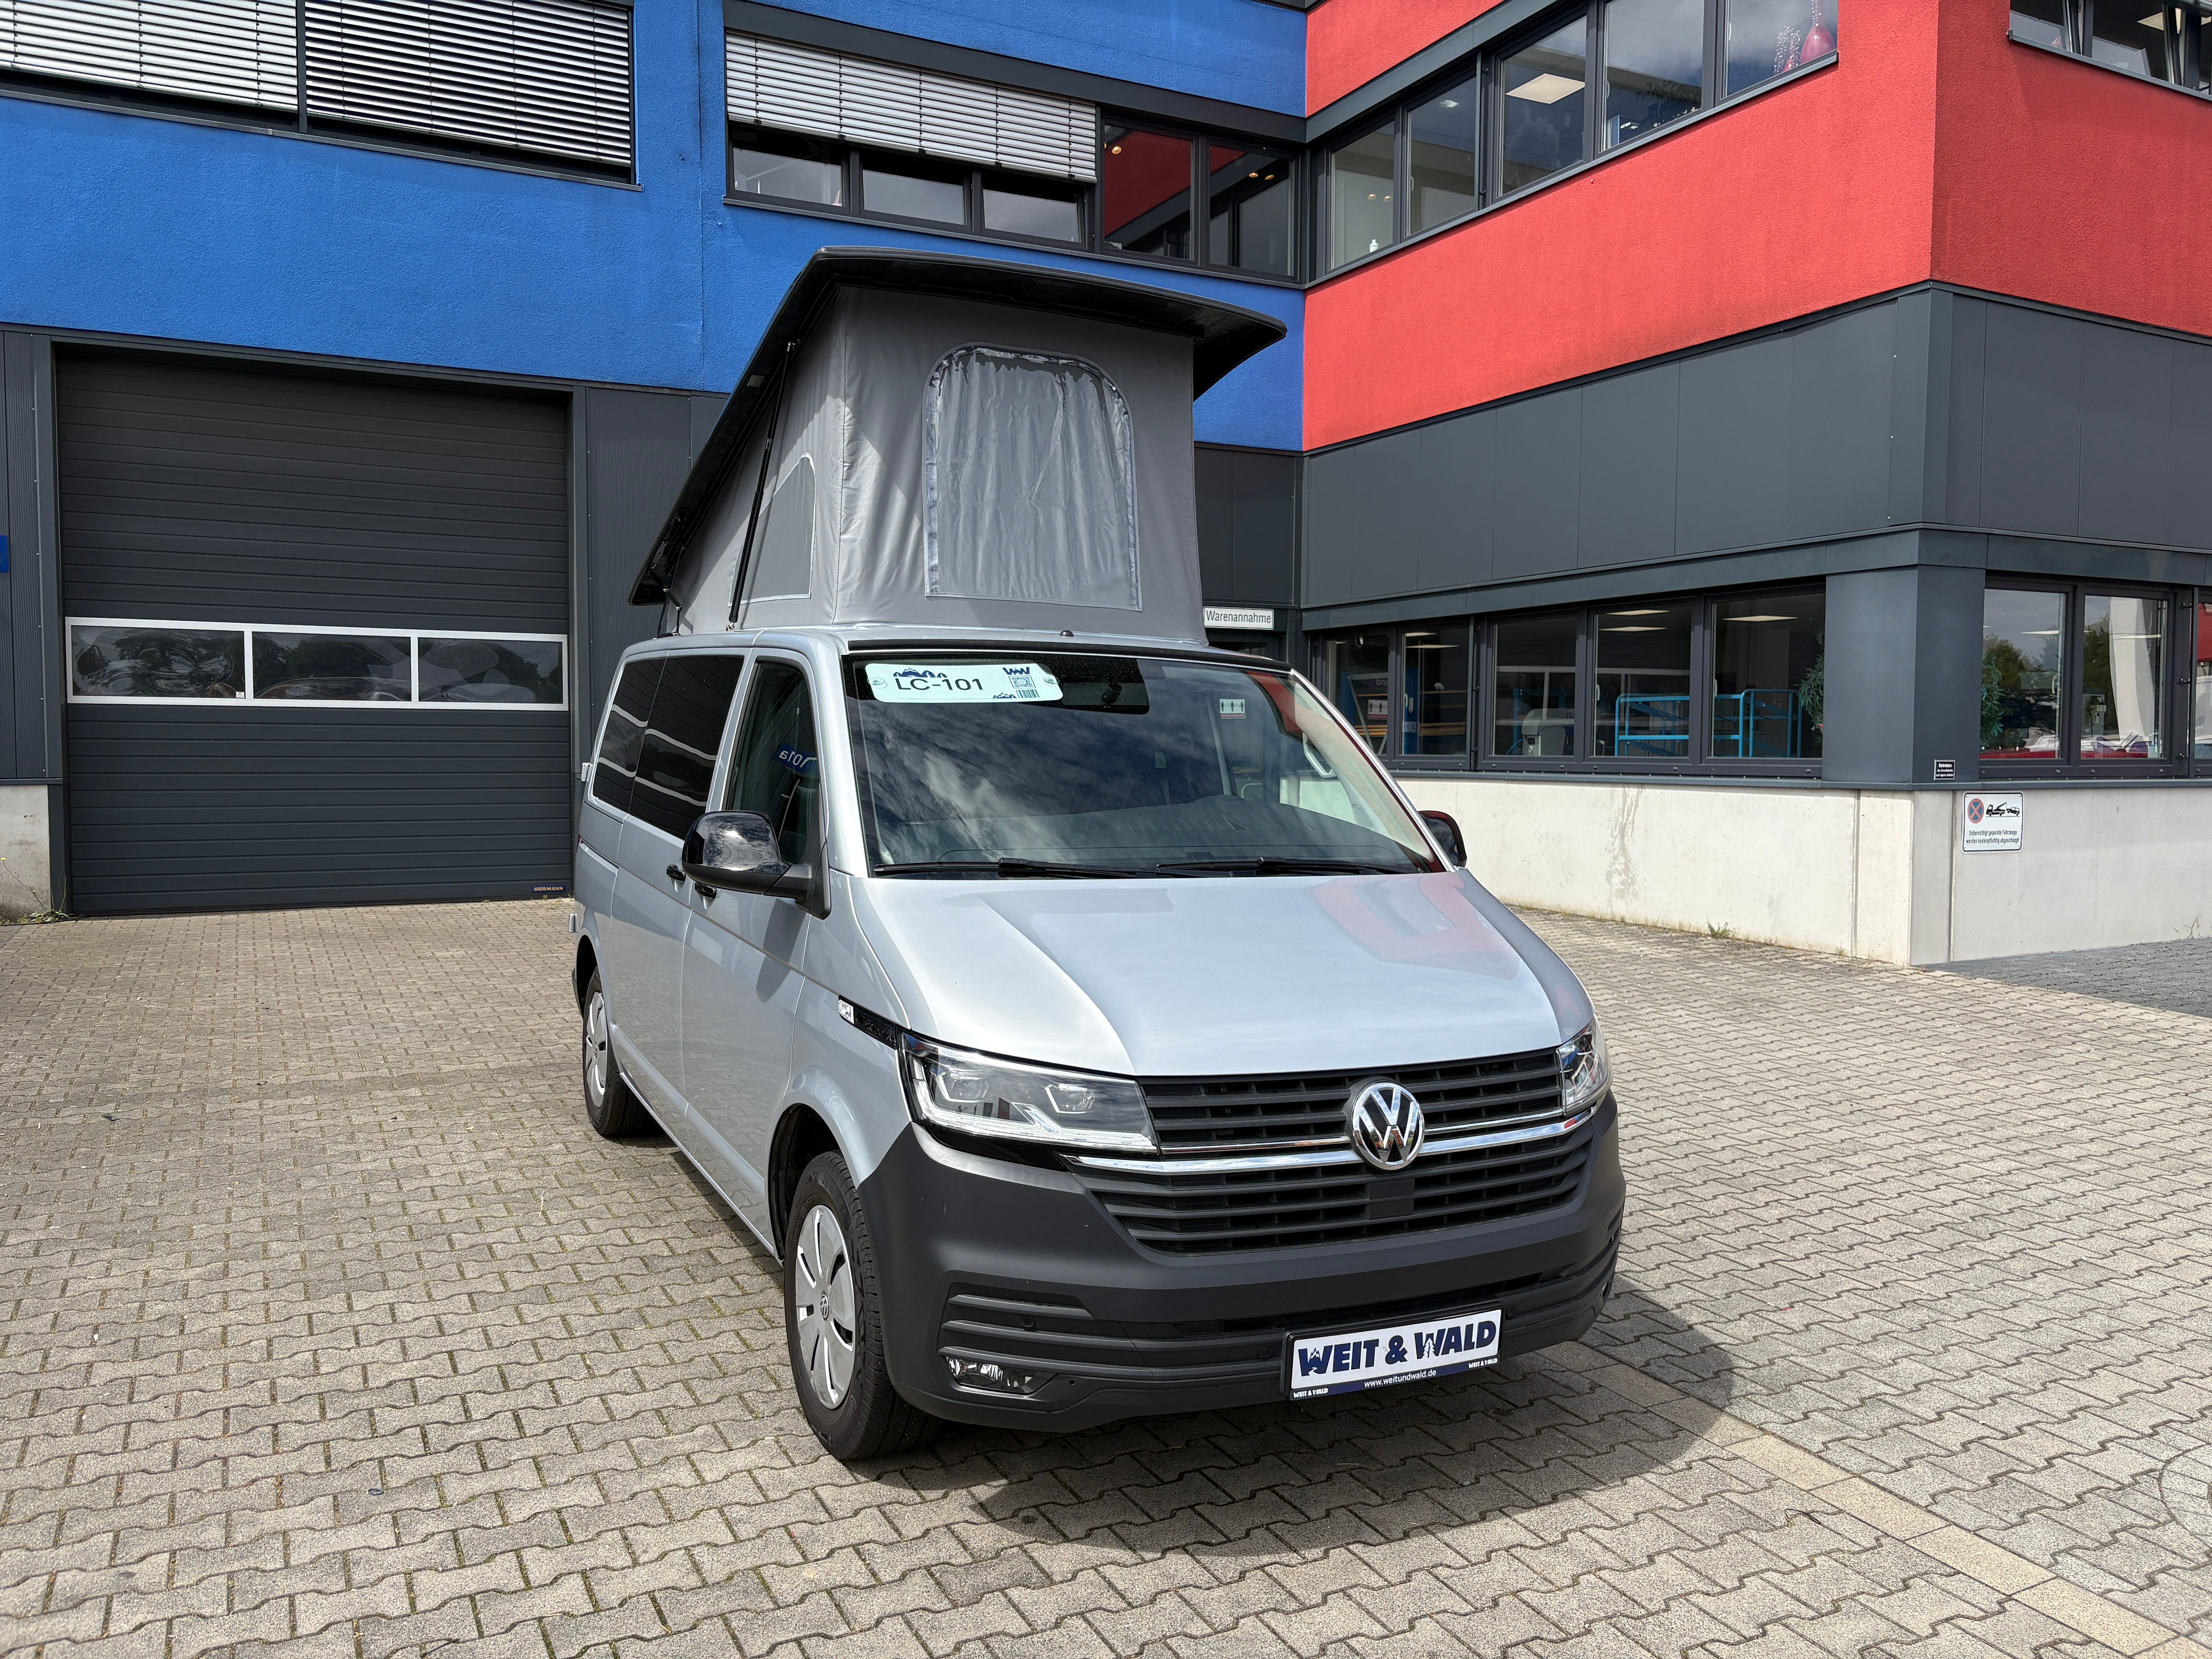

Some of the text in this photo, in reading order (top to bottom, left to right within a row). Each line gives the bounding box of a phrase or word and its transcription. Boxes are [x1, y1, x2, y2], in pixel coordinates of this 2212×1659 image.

[1206, 610, 1271, 623] Warenannahme
[895, 678, 984, 691] LC-101
[1298, 1320, 1497, 1377] WEIT & WALD
[1364, 1369, 1437, 1388] www.weitundwald.de
